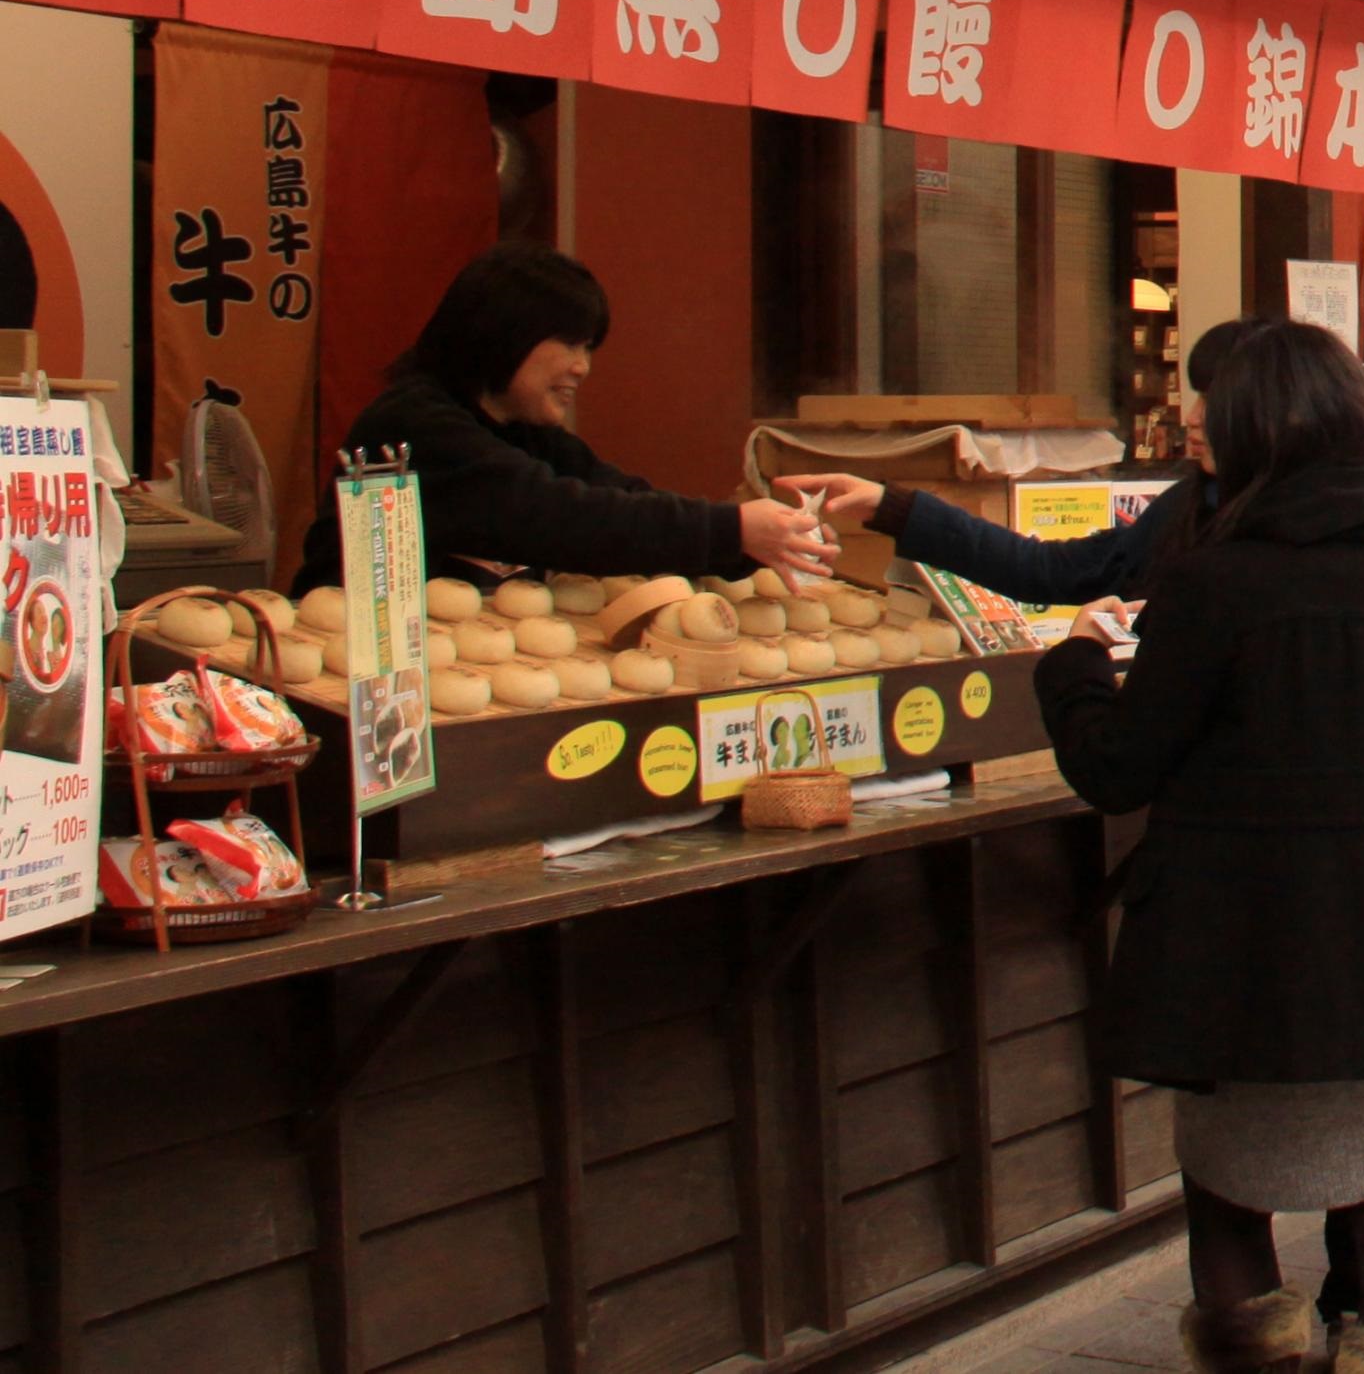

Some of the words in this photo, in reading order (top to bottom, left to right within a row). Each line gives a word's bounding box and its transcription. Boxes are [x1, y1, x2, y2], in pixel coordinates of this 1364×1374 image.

[262, 95, 313, 321] 広島牛の
[168, 206, 255, 408] 牛
[0, 472, 91, 540] 帰り用
[53, 816, 88, 846] 100円
